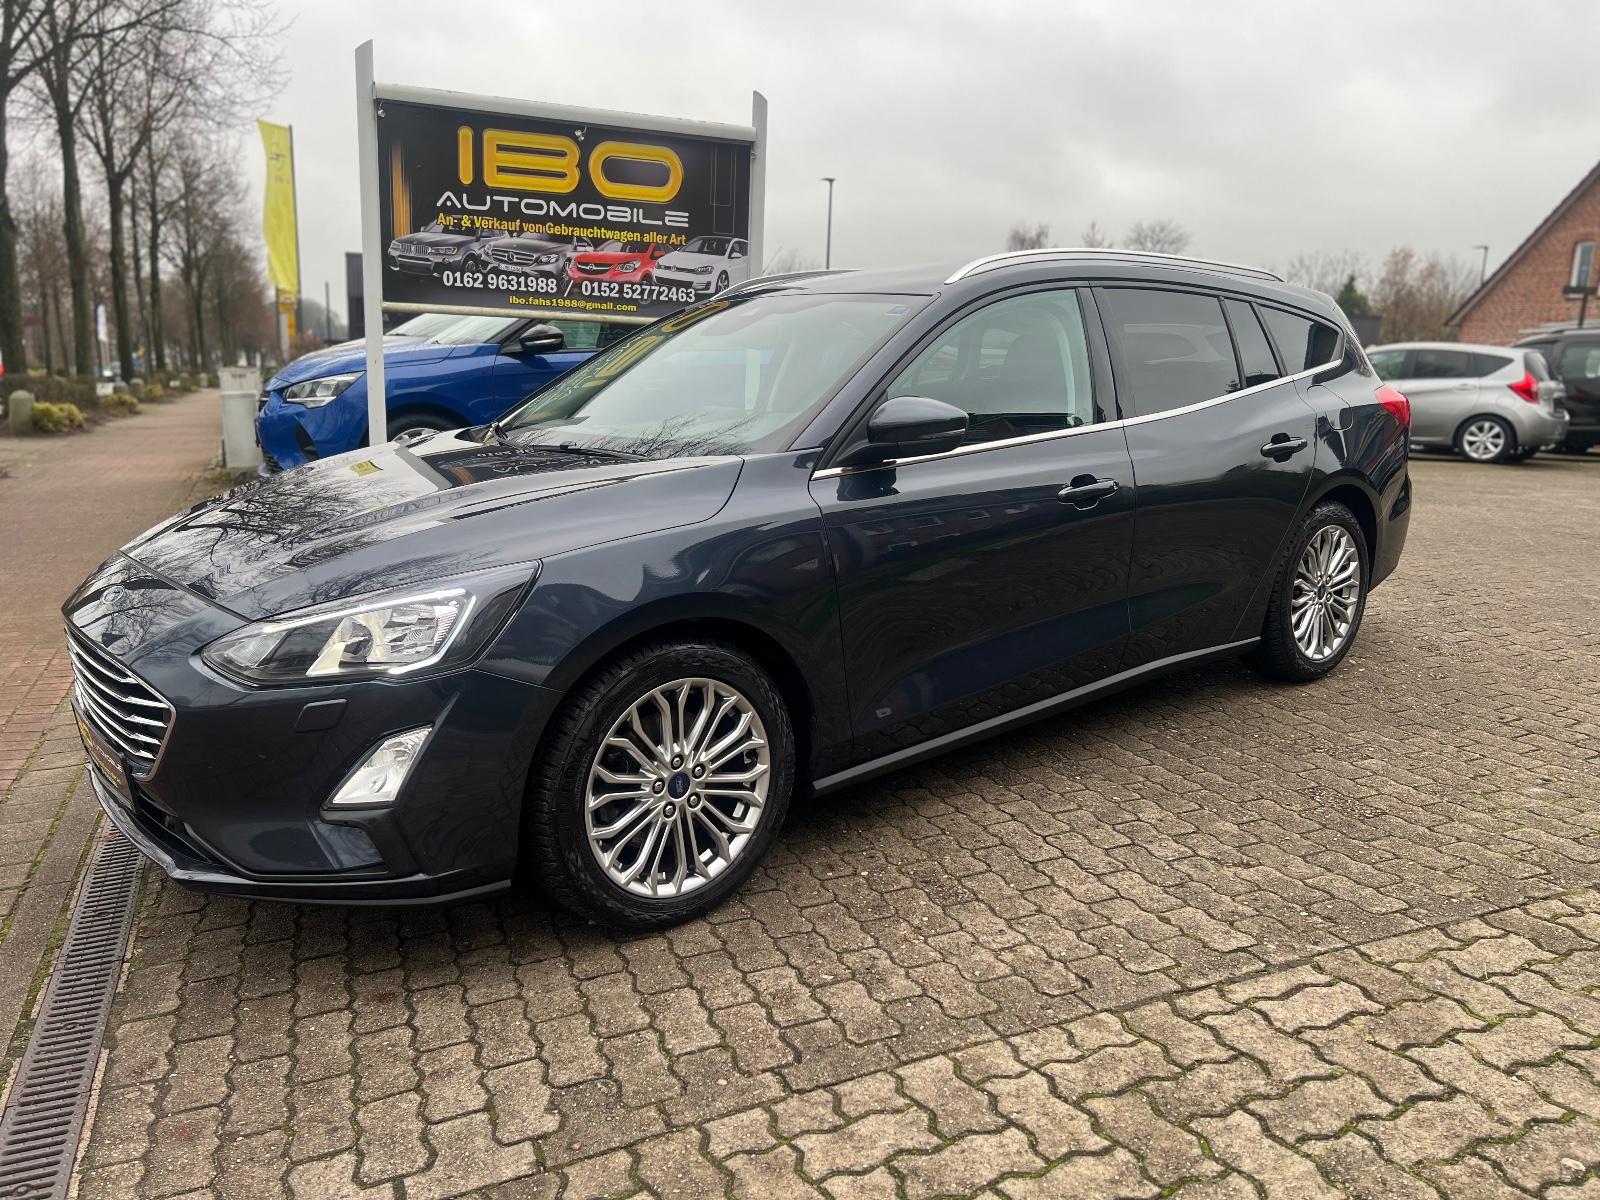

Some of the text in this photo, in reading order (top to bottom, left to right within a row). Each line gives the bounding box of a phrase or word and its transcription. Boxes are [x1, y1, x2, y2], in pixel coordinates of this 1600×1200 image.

[458, 125, 684, 203] IBO
[437, 191, 689, 227] AUTOMOBILE
[437, 213, 686, 245] An- & Verkauf von Gebrauchtwagen aller Art
[443, 271, 483, 288] 0162
[487, 273, 557, 293] 9631988
[582, 280, 619, 298] 0152
[623, 284, 696, 302] 52772463
[509, 296, 637, 312] ibo.fahs1988@gmail.com
